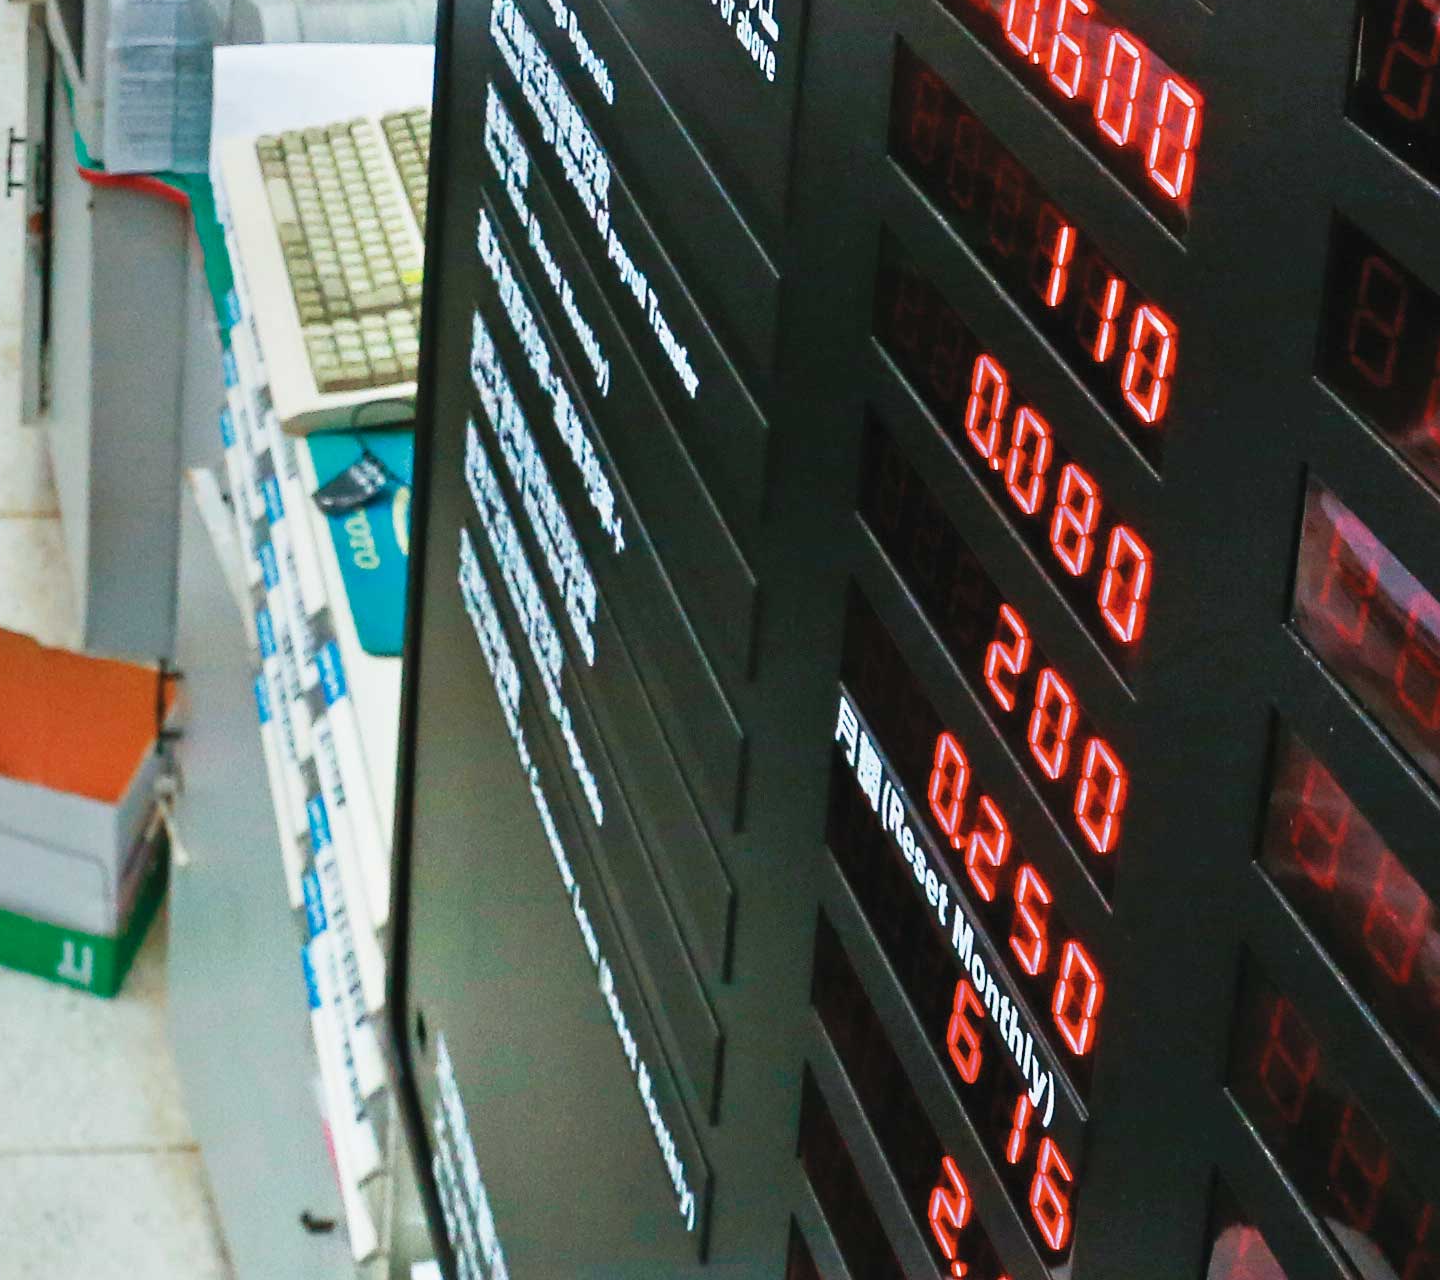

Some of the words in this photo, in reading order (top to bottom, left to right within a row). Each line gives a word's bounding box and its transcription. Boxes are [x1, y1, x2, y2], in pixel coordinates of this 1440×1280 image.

[735, 4, 777, 83] above
[1046, 225, 1171, 424] 110
[967, 353, 1149, 643] 0.080
[985, 604, 1122, 854] 200
[932, 733, 1102, 1055] 0.250
[951, 904, 1056, 1129] Monthly)
[931, 1155, 1008, 1280] 2.
